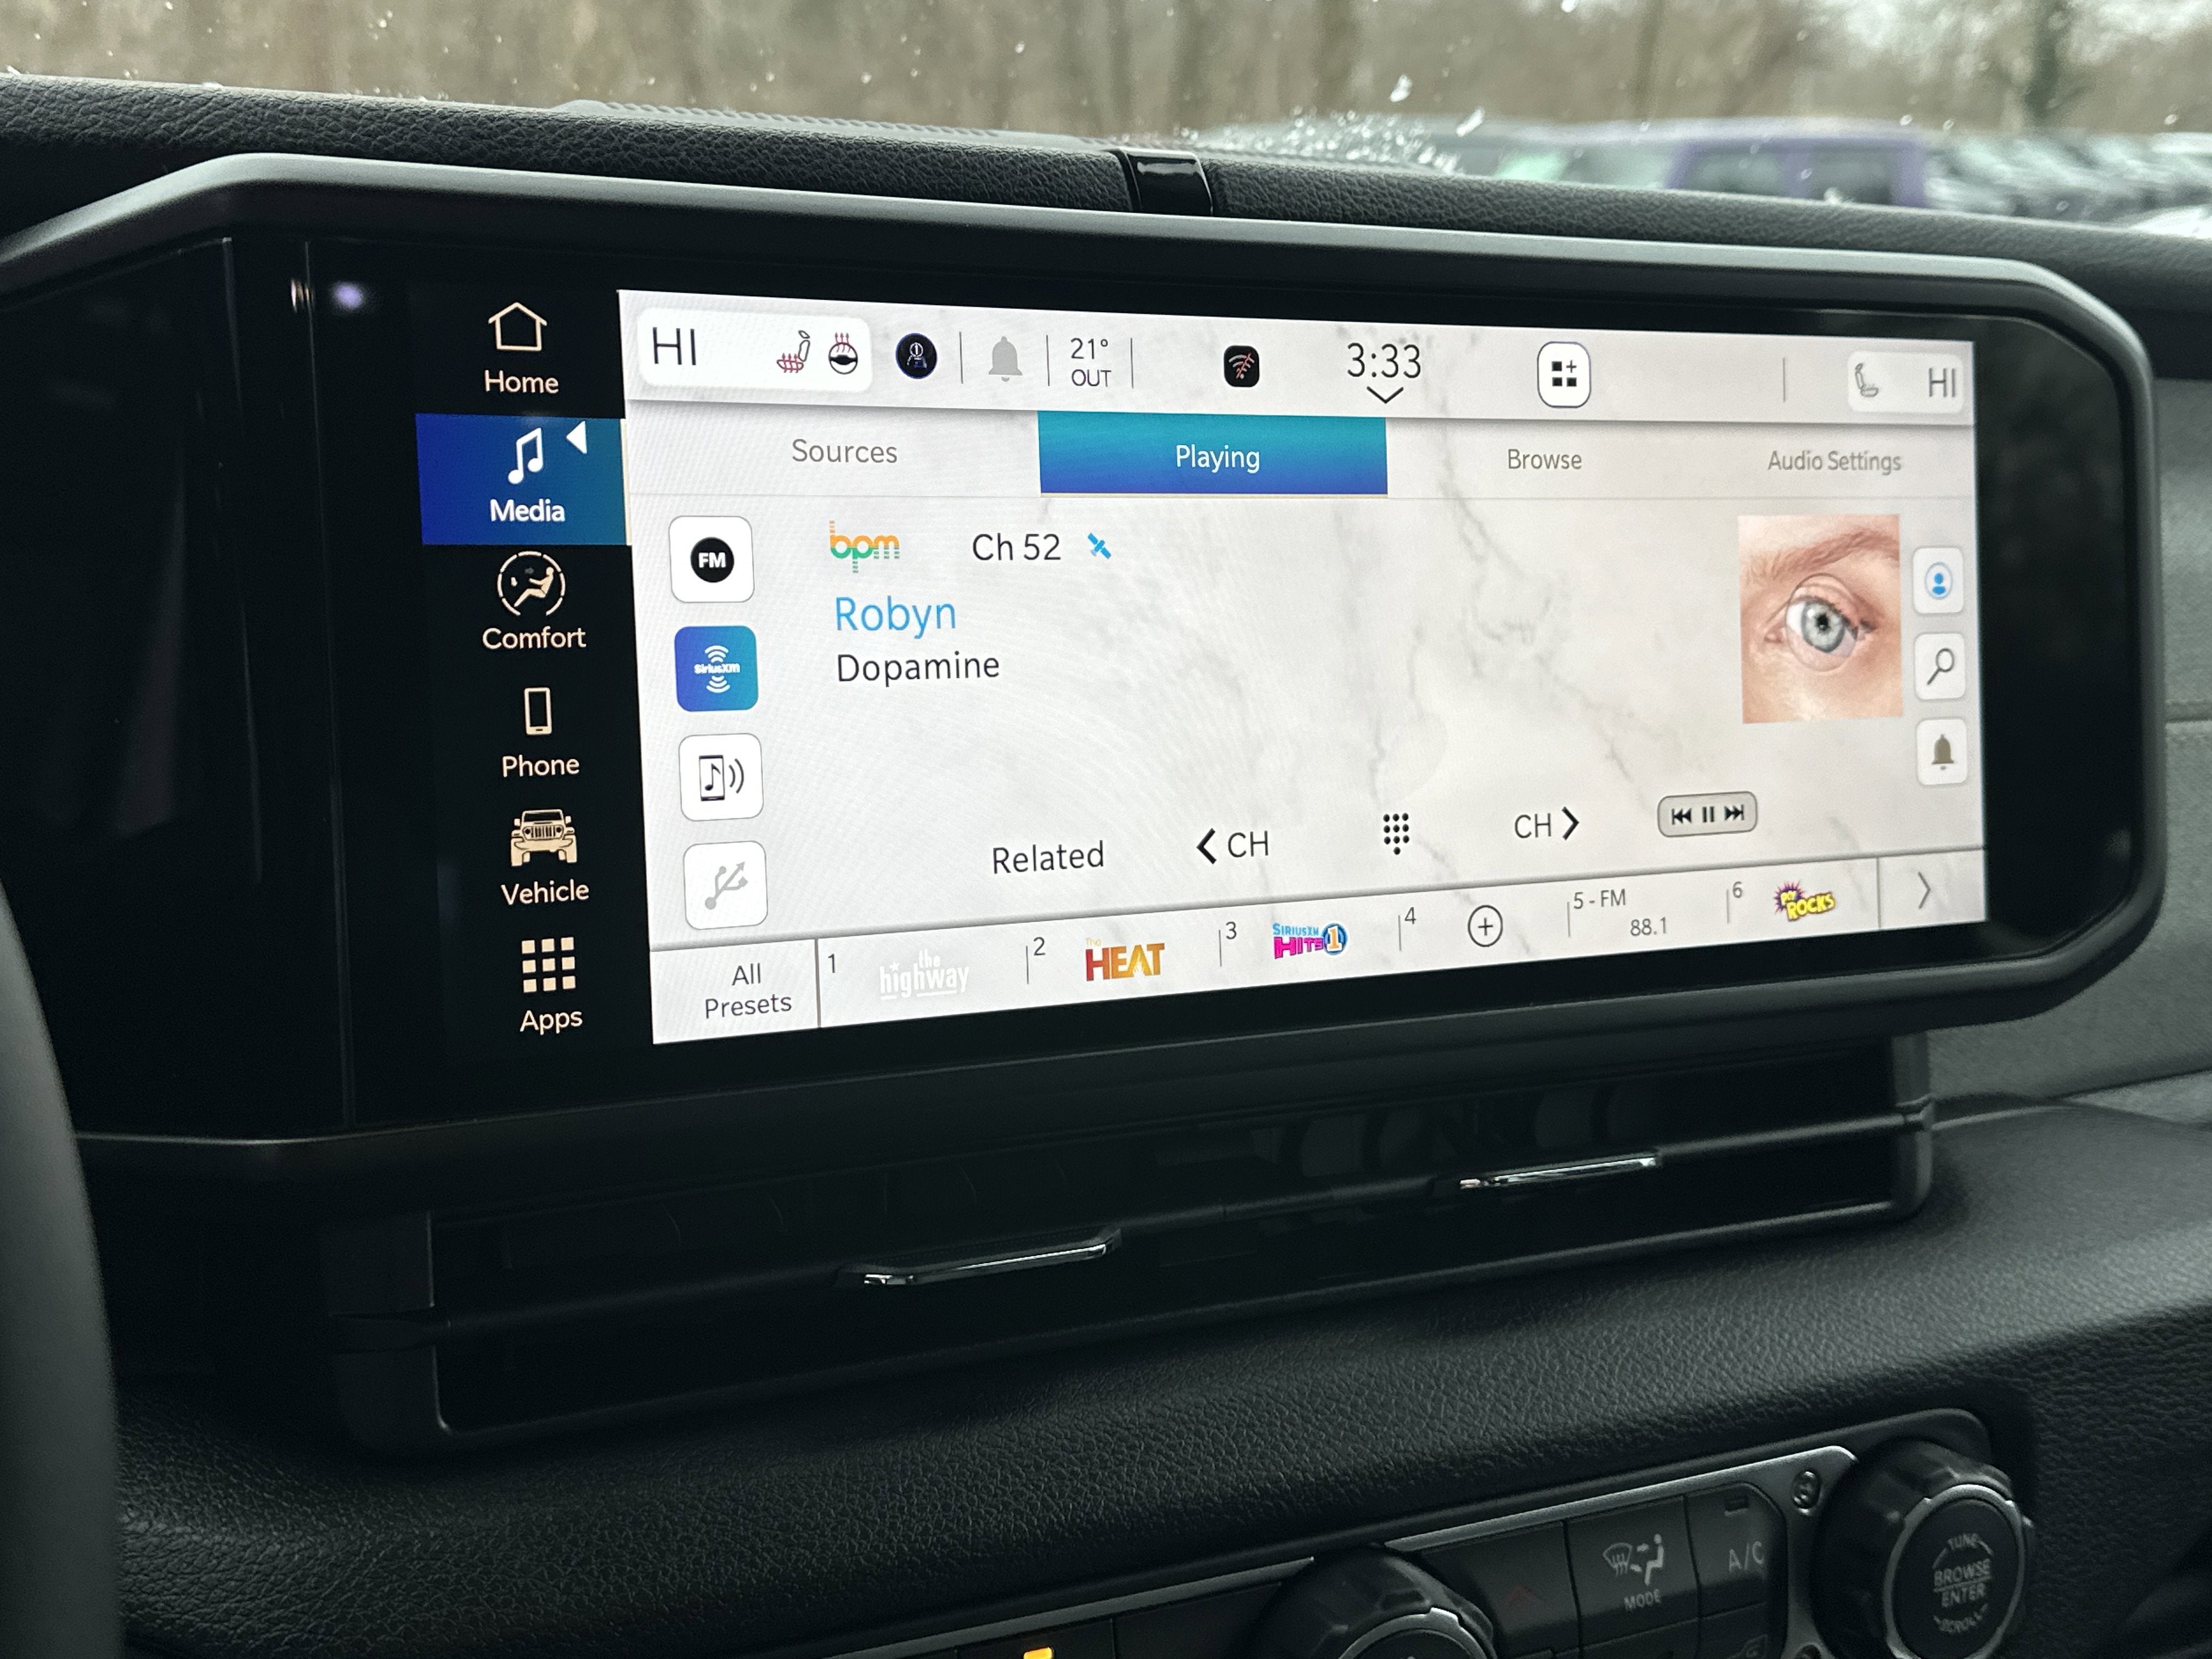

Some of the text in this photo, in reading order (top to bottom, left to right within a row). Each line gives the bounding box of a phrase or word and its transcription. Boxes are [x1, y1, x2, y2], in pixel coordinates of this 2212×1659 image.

[652, 326, 697, 366] HI
[1347, 342, 1421, 379] 3:33
[484, 370, 558, 394] Home
[1071, 370, 1111, 387] OUT
[1928, 367, 1956, 397] HI
[792, 439, 898, 463] Sources
[1176, 444, 1260, 473] Playing
[1508, 449, 1582, 470] Browse
[1767, 450, 1902, 475] Audio Settings
[490, 500, 566, 522] Media
[829, 521, 900, 574] bpm
[973, 533, 1061, 561] Ch 52
[698, 553, 726, 569] FM
[836, 595, 956, 639] Robyn
[482, 627, 587, 650] Comfort
[837, 651, 1000, 687] Dopamine
[502, 755, 580, 777] Phone
[1514, 814, 1552, 839] CH
[1228, 831, 1269, 857] CH
[993, 840, 1104, 874] Related
[501, 879, 590, 906] Vehicle
[1573, 893, 1584, 909] 5
[1600, 889, 1626, 907] FM
[1733, 881, 1742, 899] 6
[1404, 907, 1416, 925] 4
[1786, 893, 1836, 921] ROCKS
[1225, 922, 1237, 940] 3
[1630, 917, 1668, 936] 88.1
[919, 948, 941, 968] the
[1033, 937, 1046, 956] 2
[1273, 936, 1324, 960] HITS
[732, 963, 761, 986] All
[827, 953, 836, 973] 1
[1086, 943, 1165, 981] HEAT
[879, 962, 969, 998] highway
[705, 994, 792, 1019] Presets
[520, 1009, 583, 1035] Apps
[1728, 1539, 1764, 1573] A/C
[1934, 1558, 1990, 1587] BROWSE
[1624, 1588, 1661, 1611] MODE
[1942, 1582, 1986, 1608] ENTER
